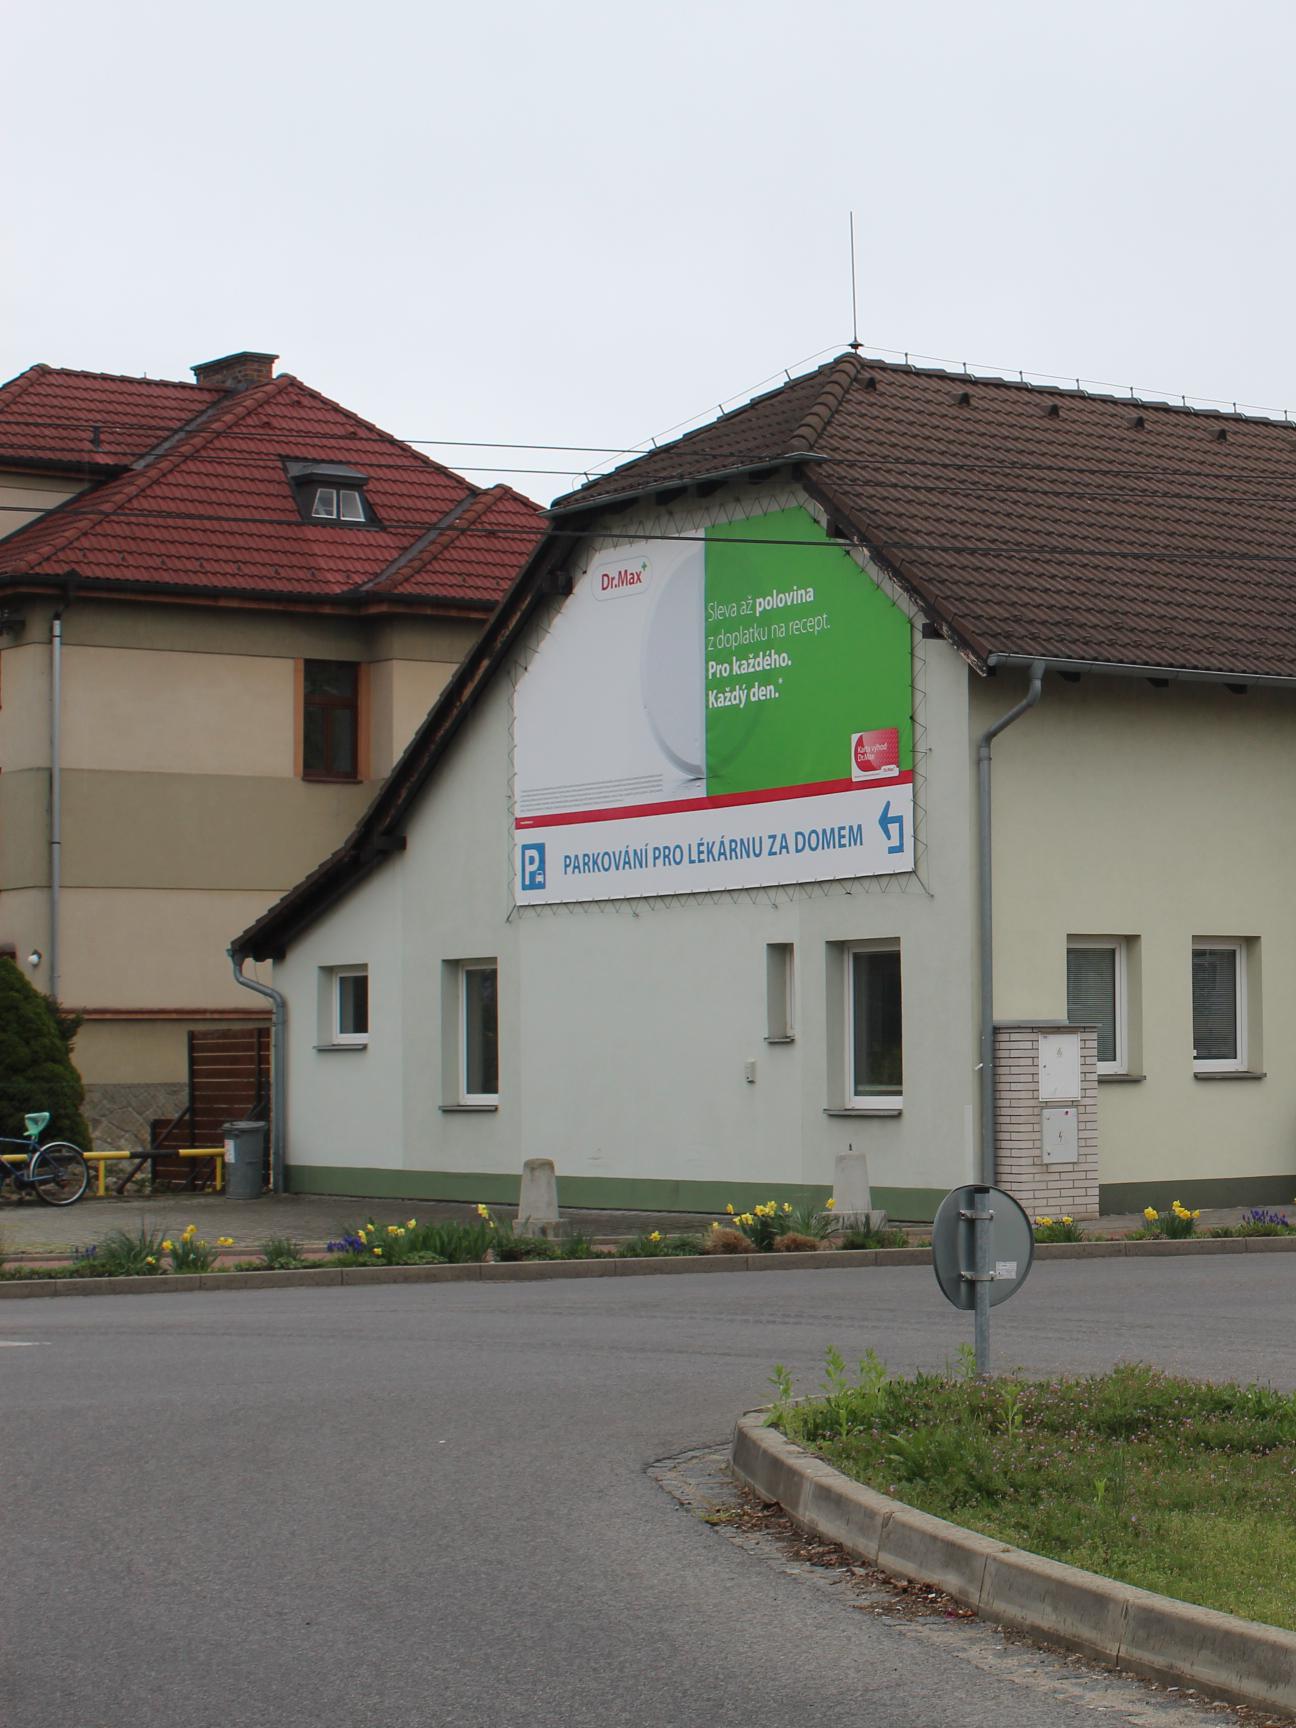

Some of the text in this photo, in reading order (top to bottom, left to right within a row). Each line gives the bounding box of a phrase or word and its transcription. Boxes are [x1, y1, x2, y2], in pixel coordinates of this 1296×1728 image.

[601, 569, 642, 591] Dr.Max
[708, 585, 814, 622] Sleva až polovina
[708, 612, 831, 651] z doplatku na recept.
[708, 649, 792, 679] Pro každého.
[708, 684, 747, 708] Každý
[524, 849, 540, 885] P
[563, 823, 864, 875] PARKOVÁNÍ PRO LÉKÁRNU ZA DOMEM
